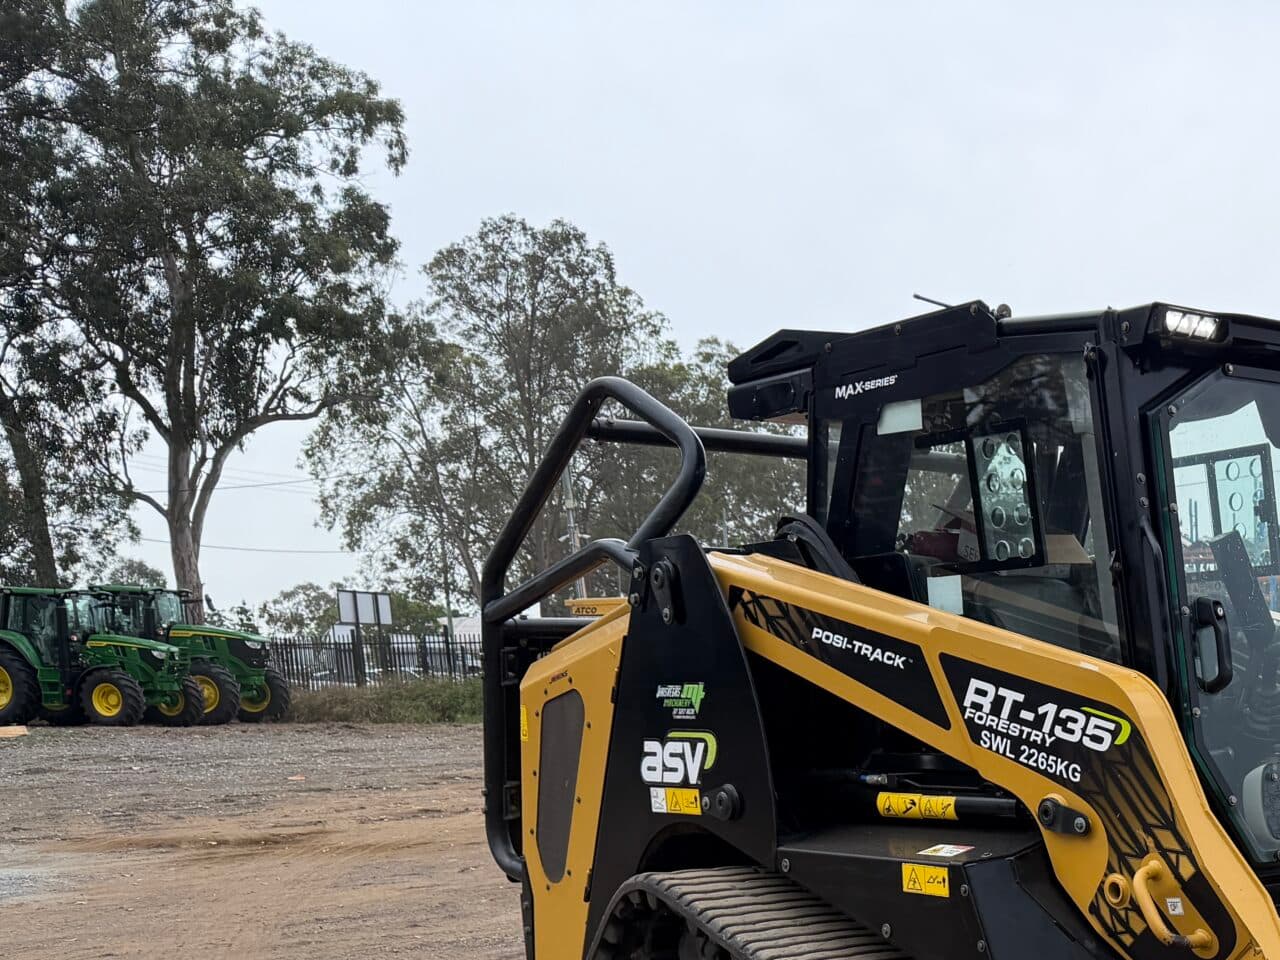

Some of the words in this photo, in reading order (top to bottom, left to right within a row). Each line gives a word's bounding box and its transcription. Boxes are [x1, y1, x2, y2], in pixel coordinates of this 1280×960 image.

[574, 606, 598, 614] ATCO
[811, 627, 907, 670] POSI-TRACK
[963, 677, 1117, 752] RT-135
[964, 708, 1057, 748] FORESTRY
[979, 730, 1016, 760] SWL
[1018, 745, 1083, 783] 2265KG
